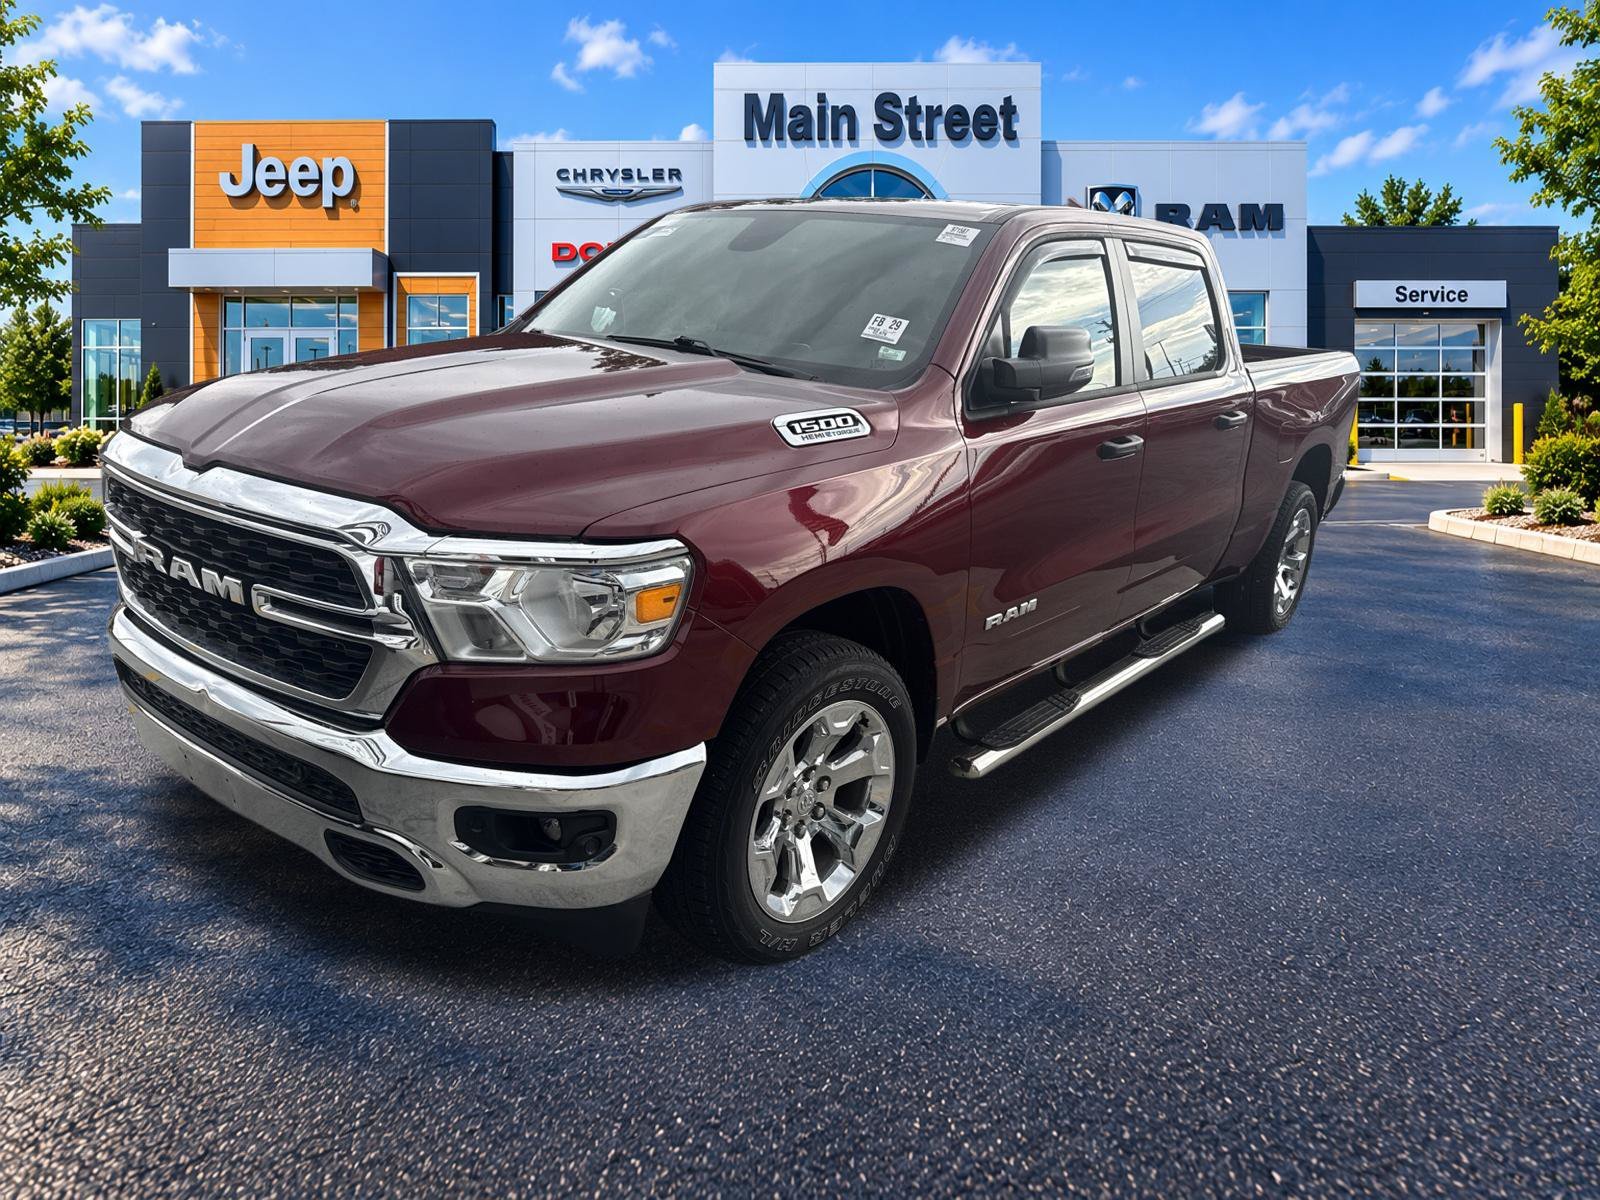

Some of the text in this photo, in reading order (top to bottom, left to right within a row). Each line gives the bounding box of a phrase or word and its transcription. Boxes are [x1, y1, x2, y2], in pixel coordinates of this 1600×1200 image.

[744, 91, 1018, 141] Main Street
[219, 143, 354, 208] Jeep
[556, 168, 683, 182] CHRYSLER
[1155, 203, 1284, 231] RAM
[551, 242, 616, 262] DO
[1395, 285, 1469, 303] Service
[871, 316, 903, 331] FB 29
[791, 415, 854, 434] 1500
[800, 432, 826, 441] HEMI
[134, 537, 246, 606] RAM
[984, 597, 1038, 631] RAM
[752, 677, 902, 794] BRIDGESTONE
